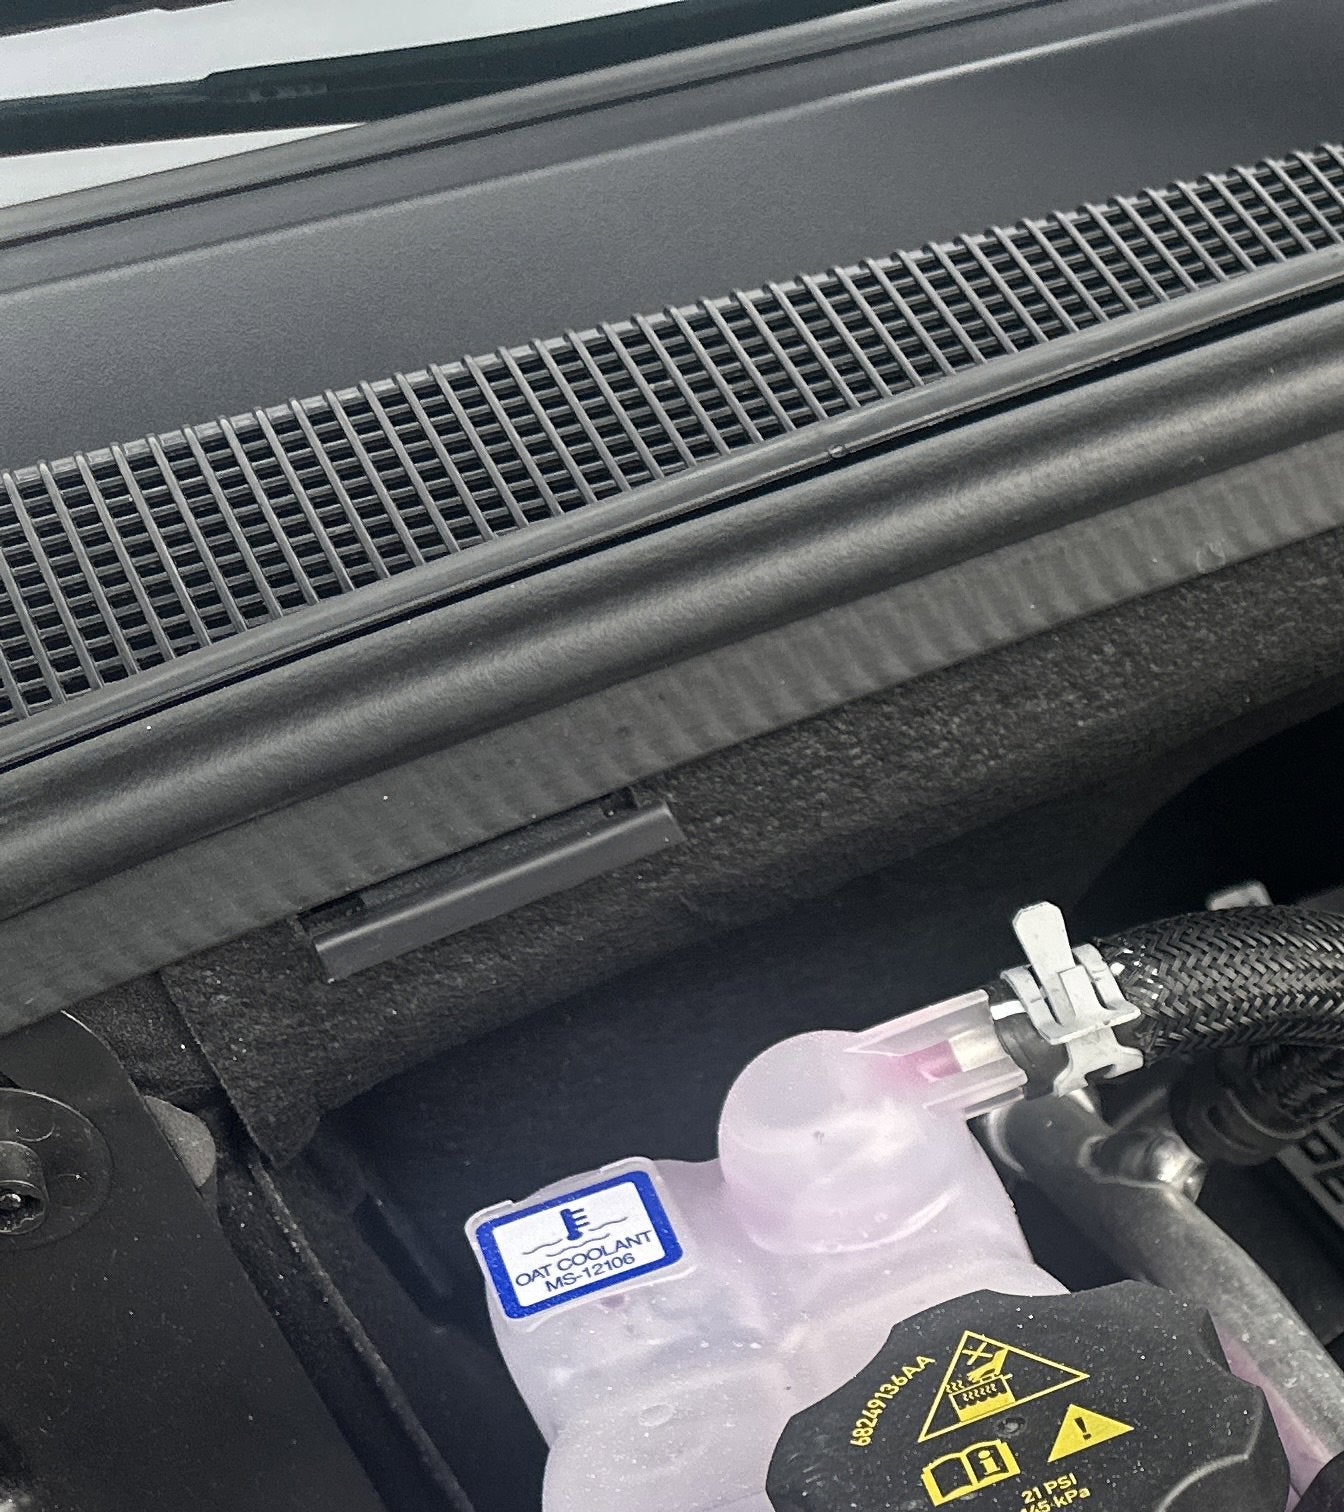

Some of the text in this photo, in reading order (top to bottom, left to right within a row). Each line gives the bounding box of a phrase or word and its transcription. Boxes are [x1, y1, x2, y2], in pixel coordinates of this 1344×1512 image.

[515, 1230, 653, 1287] OAT COOLANT
[545, 1252, 635, 1292] MS-12106
[849, 1355, 936, 1446] 68249136AA
[1021, 1472, 1077, 1504] 21 PSI
[1053, 1487, 1091, 1508] kPa
